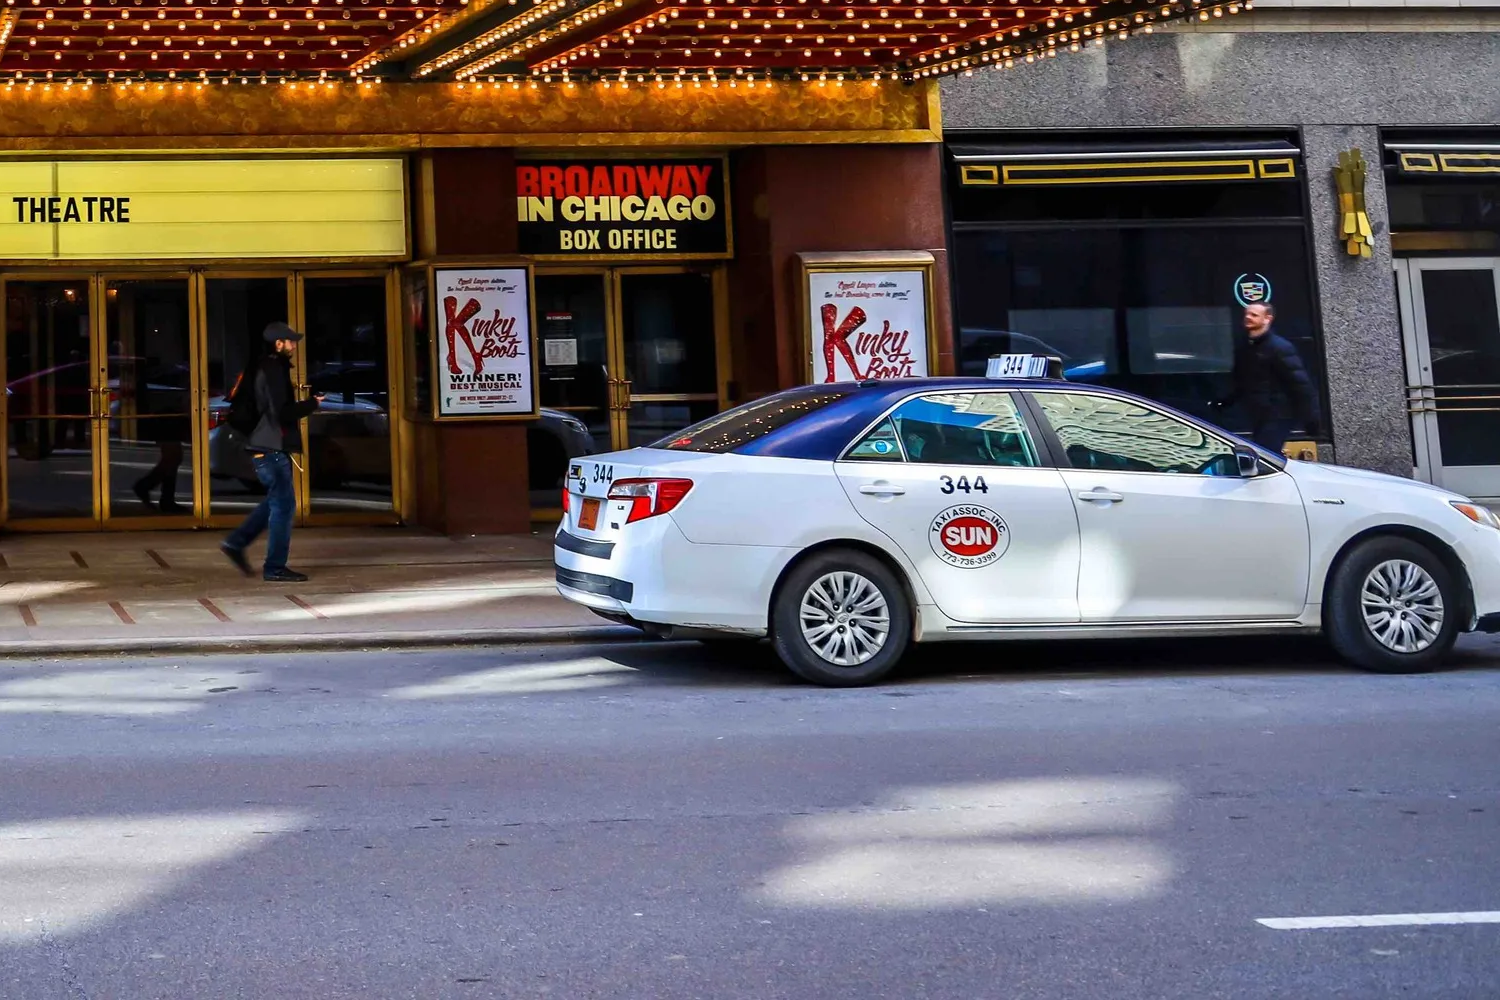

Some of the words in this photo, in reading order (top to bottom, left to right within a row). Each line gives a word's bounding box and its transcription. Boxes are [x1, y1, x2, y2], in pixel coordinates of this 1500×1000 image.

[515, 165, 713, 199] BROADWAY
[12, 196, 130, 224] THEATRE
[517, 196, 554, 222] IN
[560, 195, 716, 222] CHICAGO
[560, 229, 601, 250] BOX
[608, 228, 677, 249] OFFICE
[481, 339, 526, 358] Boots
[1003, 354, 1024, 375] 344
[450, 373, 522, 383] WINNER!
[450, 382, 477, 391] BEST
[478, 381, 522, 390] MUSICAL
[593, 463, 614, 485] 344
[939, 474, 989, 495] 344
[932, 512, 951, 533] TAXI
[945, 526, 992, 546] SUN
